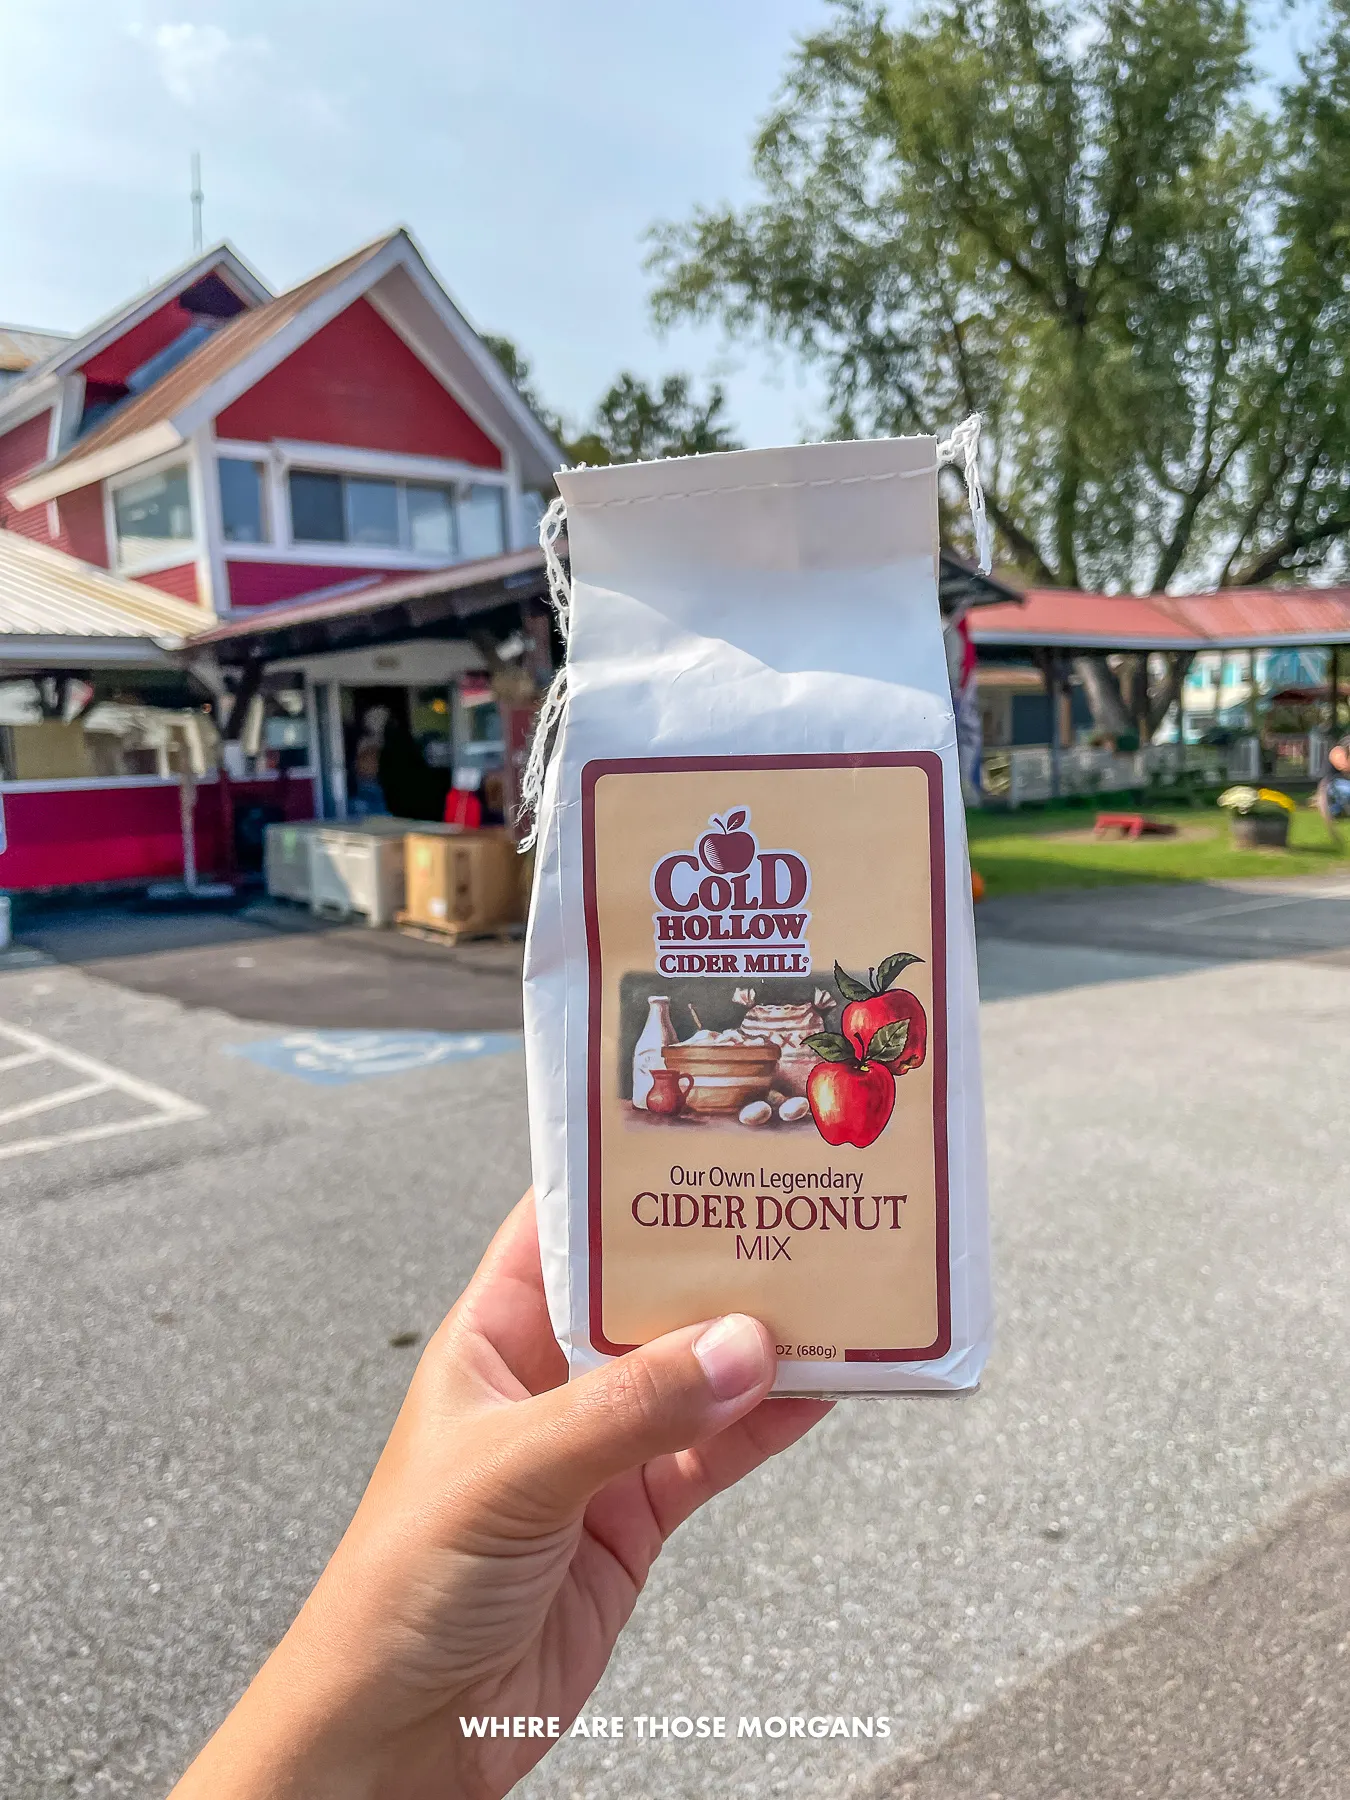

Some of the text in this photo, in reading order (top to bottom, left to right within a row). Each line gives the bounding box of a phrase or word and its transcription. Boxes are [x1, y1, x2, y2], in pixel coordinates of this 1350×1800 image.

[654, 853, 808, 913] COLD
[656, 914, 808, 941] HOLLOW
[659, 954, 739, 973] CIDER
[669, 1165, 864, 1195] Our Own Legendary
[631, 1191, 908, 1231] CIDER DONUT
[736, 1234, 793, 1261] MIX
[775, 1344, 837, 1359] OZ (680g)
